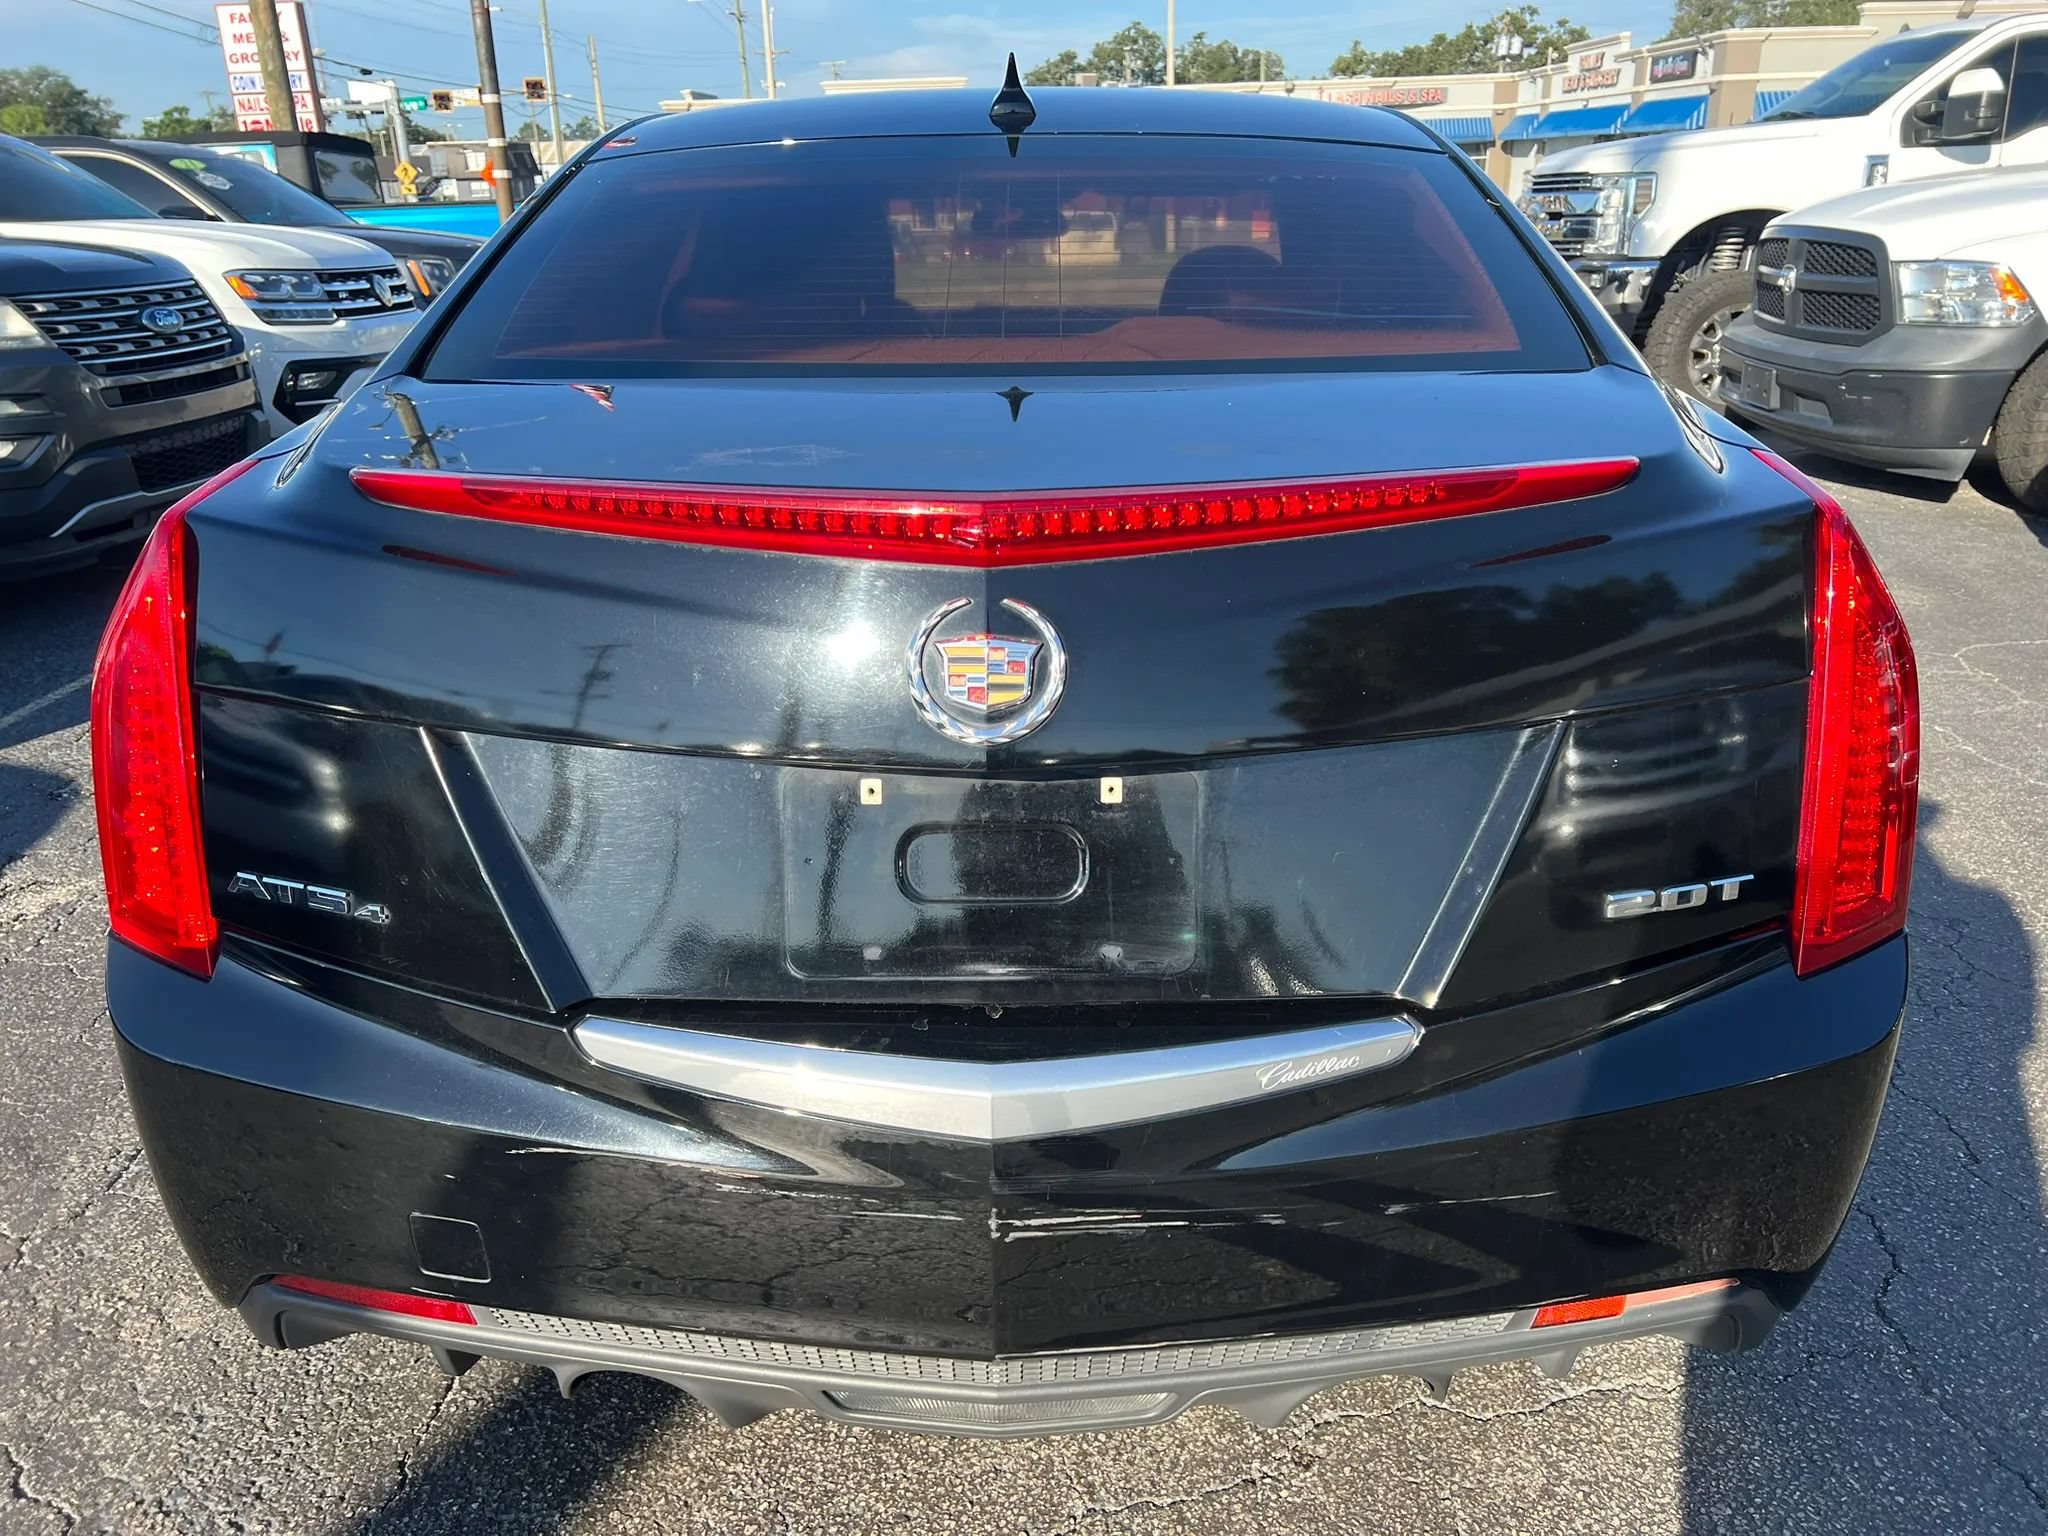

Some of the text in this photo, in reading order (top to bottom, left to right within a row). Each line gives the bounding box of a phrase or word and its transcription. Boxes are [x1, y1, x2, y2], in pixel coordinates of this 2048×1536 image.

[1407, 89, 1418, 104] &
[1420, 88, 1442, 104] SPA
[154, 309, 179, 326] Ford
[1255, 1055, 1361, 1090] Cadillac
